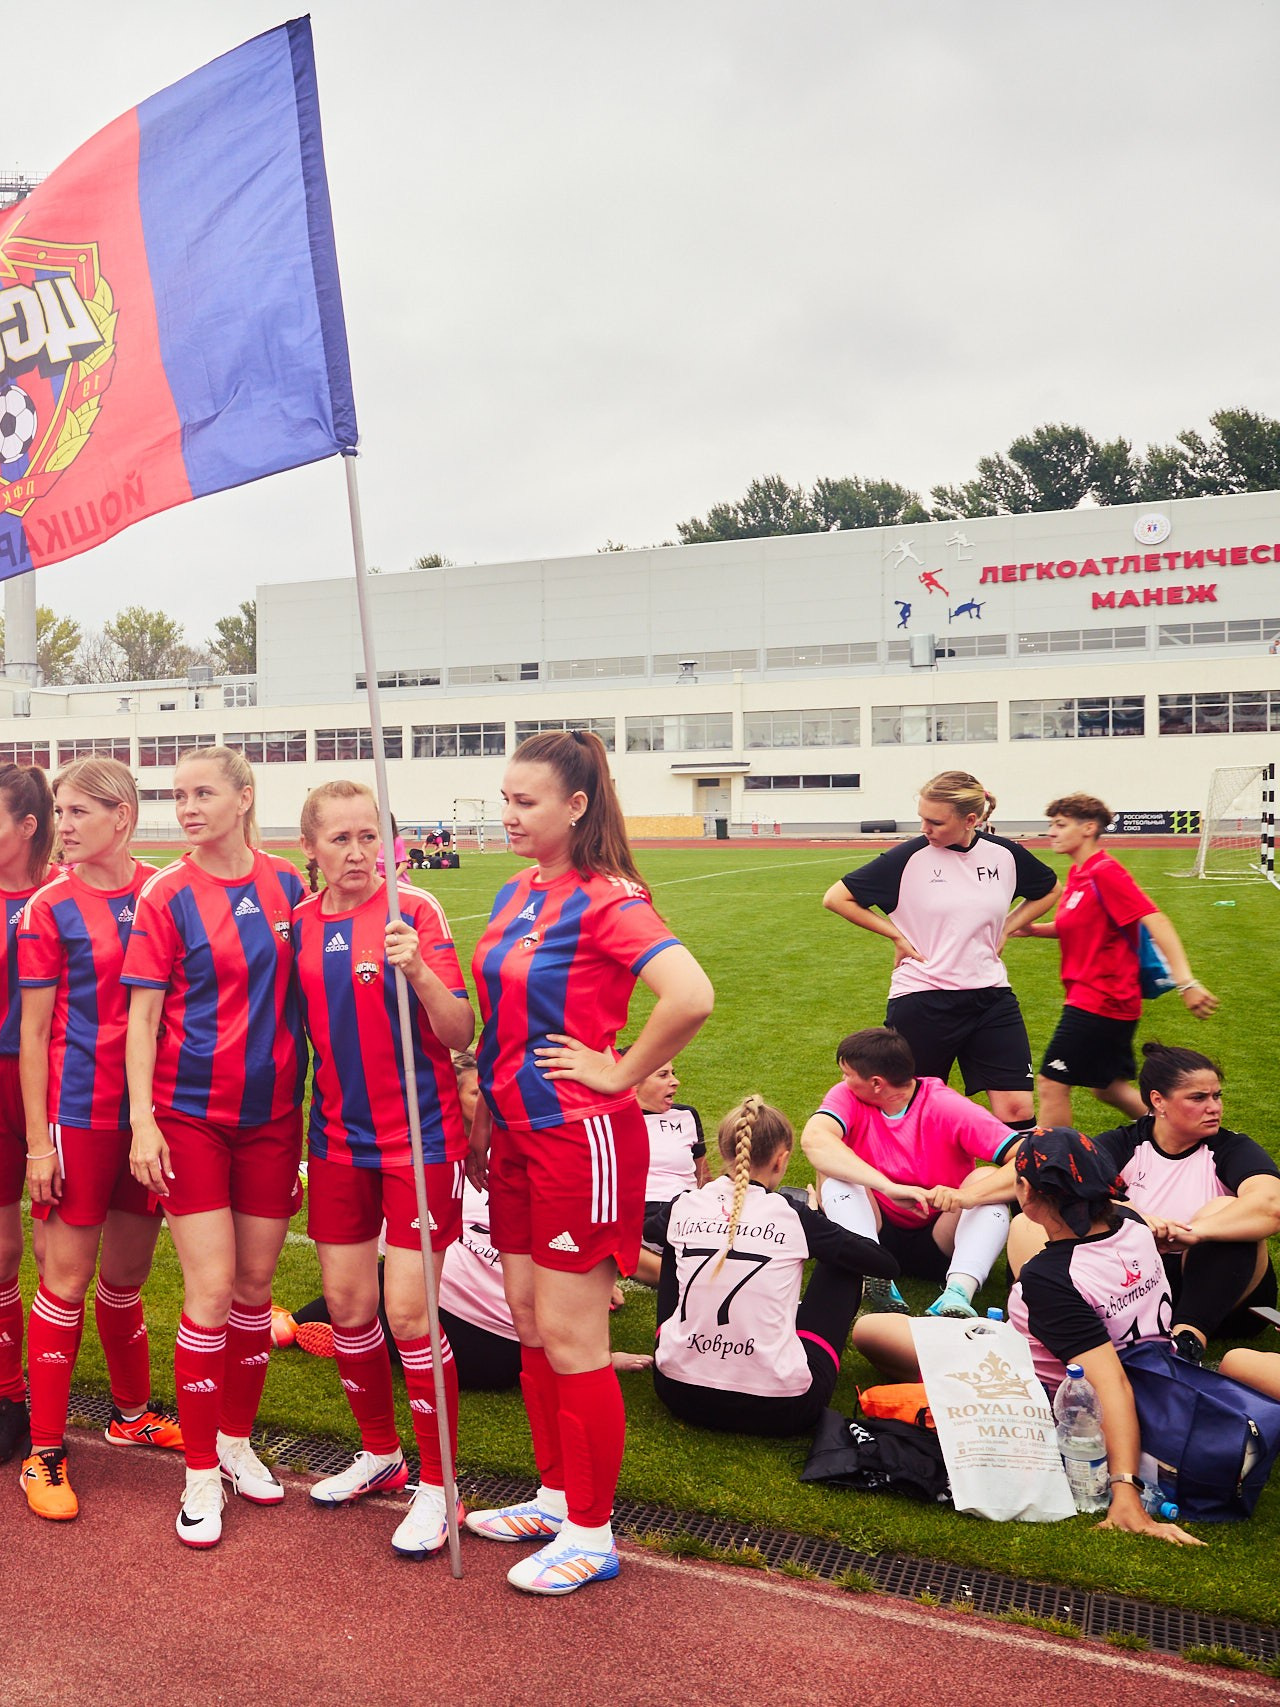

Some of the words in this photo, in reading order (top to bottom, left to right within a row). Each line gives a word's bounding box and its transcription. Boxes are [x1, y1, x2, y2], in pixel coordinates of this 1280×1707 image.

[1091, 583, 1219, 610] МАНЕЖ
[976, 865, 1000, 882] FM
[235, 906, 260, 917] adidas
[325, 944, 349, 953] adidas
[659, 1119, 683, 1134] FM
[674, 1217, 787, 1245] Максимова
[464, 1239, 502, 1267] Ковр
[548, 1241, 580, 1253] adidas
[681, 1242, 773, 1326] 77
[687, 1333, 755, 1359] Ковров
[946, 1403, 1019, 1419] ROYAL
[977, 1425, 1046, 1442] МАСЛА
